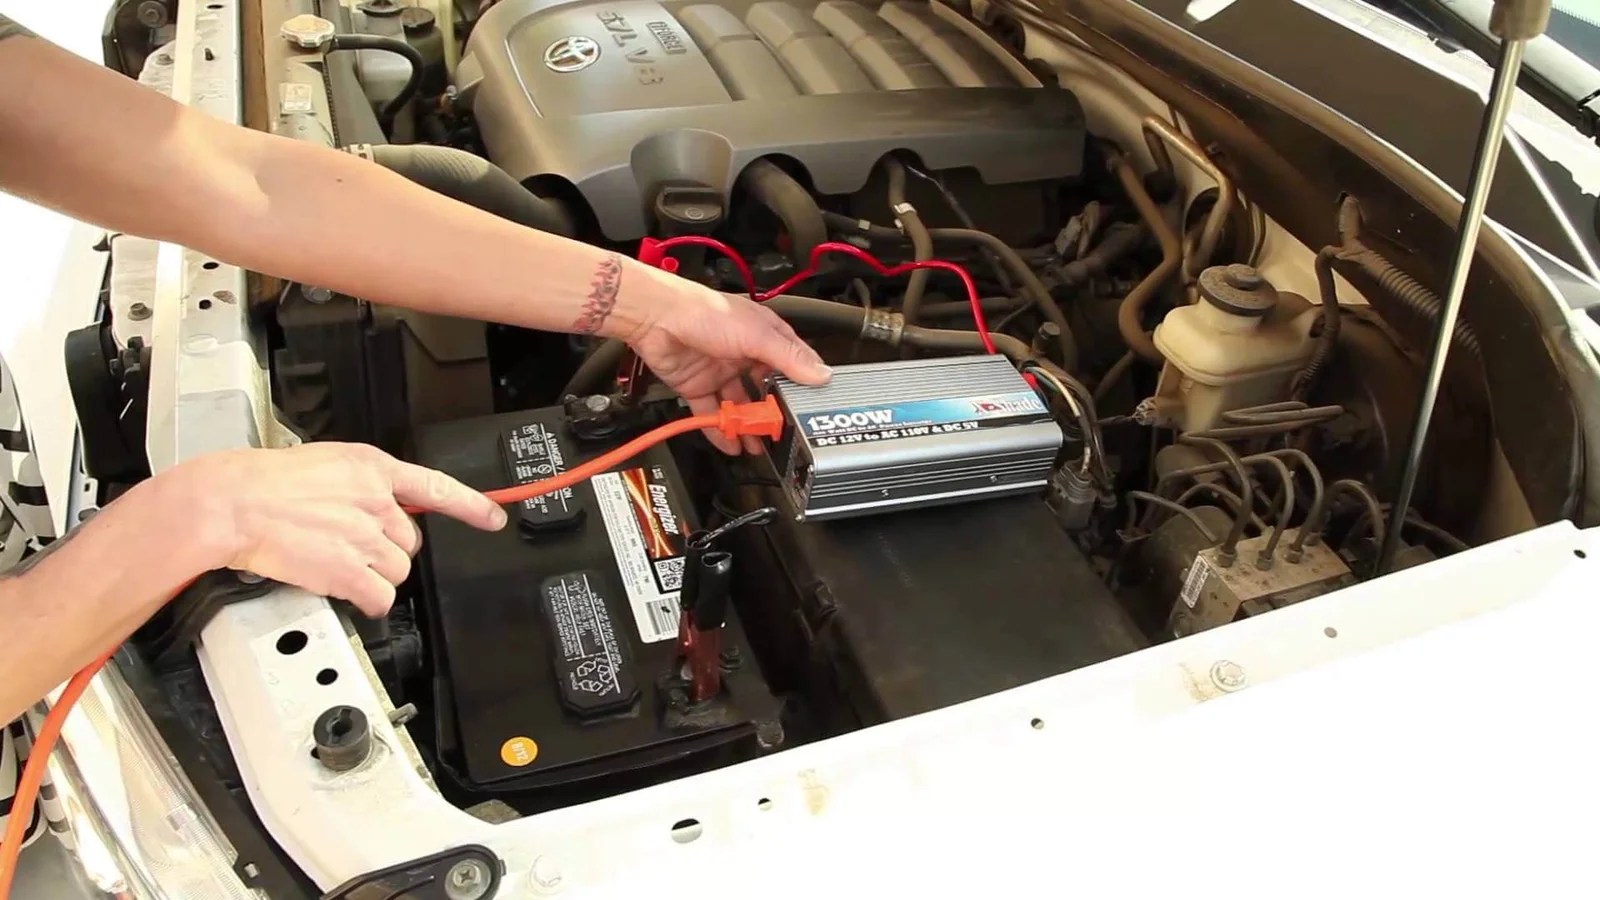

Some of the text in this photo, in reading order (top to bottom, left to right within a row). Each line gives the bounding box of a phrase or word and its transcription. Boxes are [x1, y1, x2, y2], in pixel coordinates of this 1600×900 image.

[807, 409, 893, 432] 1300W
[816, 436, 837, 446] DC
[843, 434, 862, 443] 12V
[864, 432, 879, 441] to
[881, 429, 898, 439] AC
[901, 426, 929, 437] 110V
[932, 424, 942, 434] &
[943, 422, 961, 431] DC
[963, 421, 979, 430] 5V
[548, 438, 564, 466] DANGER
[648, 484, 679, 535] Energizer
